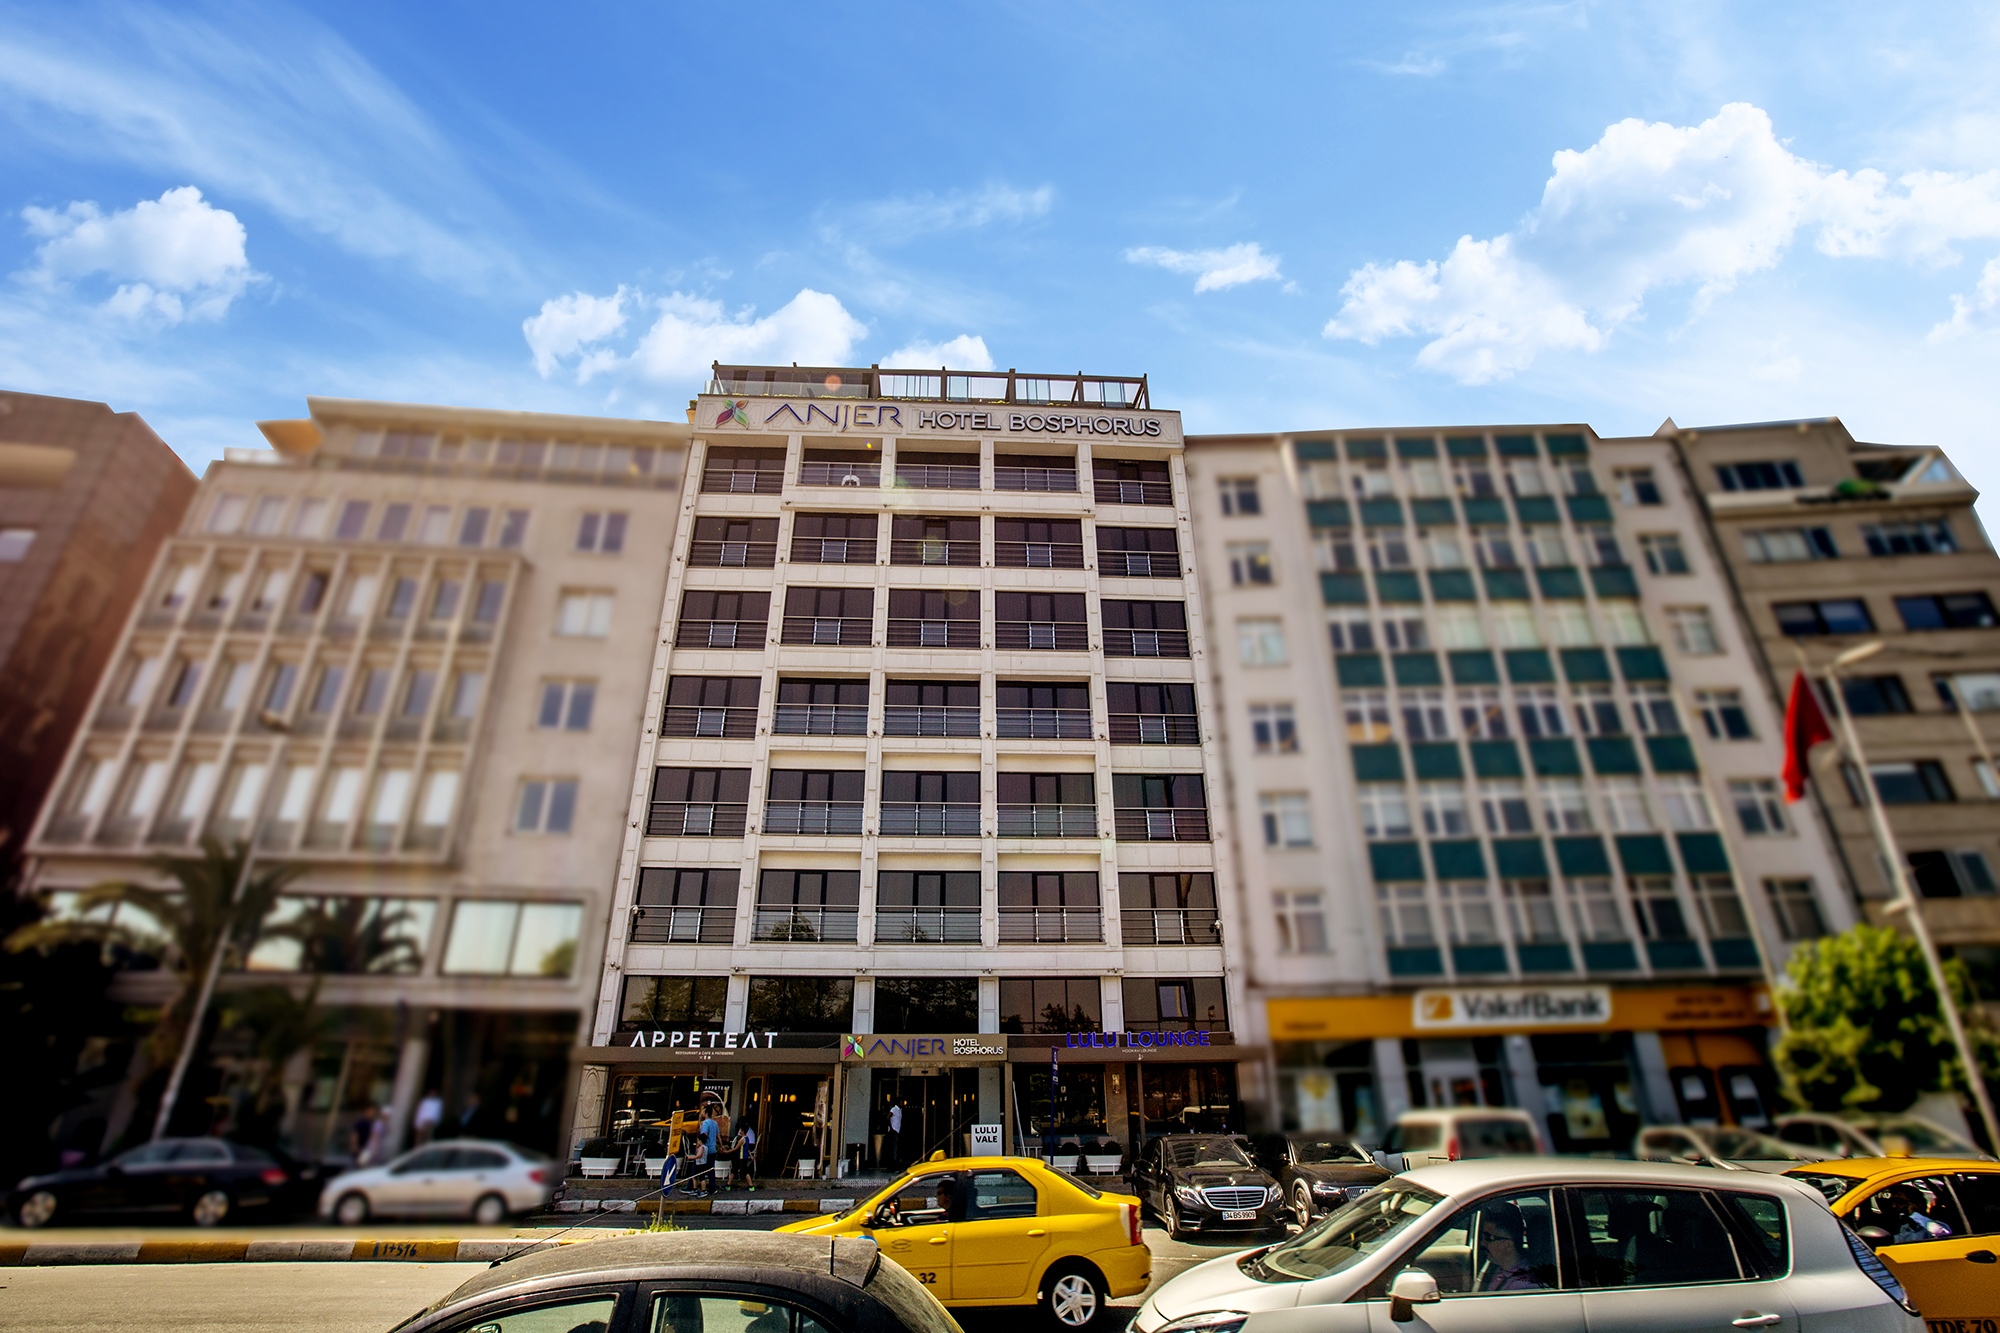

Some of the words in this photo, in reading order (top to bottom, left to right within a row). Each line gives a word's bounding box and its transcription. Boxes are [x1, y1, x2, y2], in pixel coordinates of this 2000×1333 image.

[764, 402, 904, 432] ANJER
[918, 410, 1002, 432] HOTEL
[1008, 413, 1161, 437] BOSPHORUS
[630, 1030, 778, 1049] APPETEAT
[953, 1038, 981, 1047] HOTEL
[1066, 1031, 1117, 1049] LULU
[1127, 1030, 1211, 1048] LOUNGE
[868, 1039, 946, 1059] ANJER
[953, 1046, 1004, 1055] BOSPHORUS
[975, 1135, 998, 1143] VALE
[919, 1272, 937, 1284] 32
